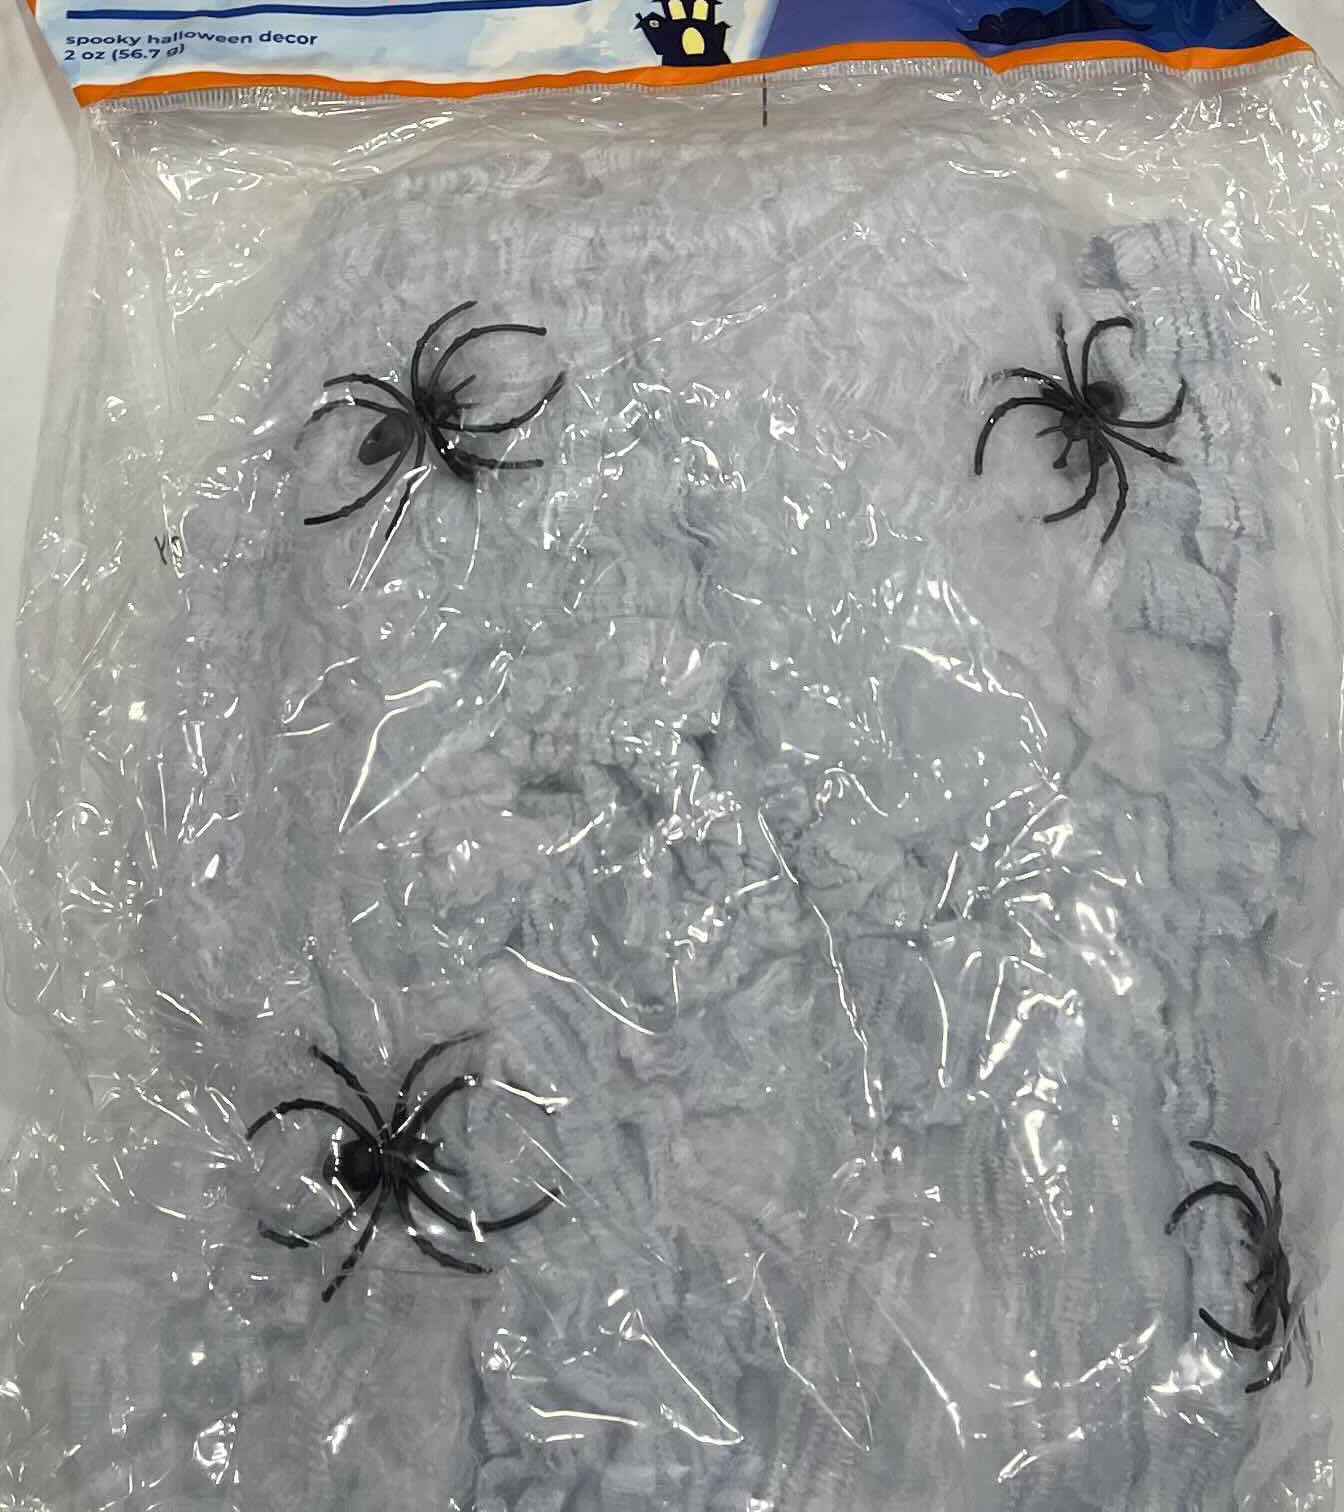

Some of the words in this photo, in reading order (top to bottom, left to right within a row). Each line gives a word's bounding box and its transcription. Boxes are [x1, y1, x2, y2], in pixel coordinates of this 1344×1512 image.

[65, 33, 141, 50] spooky
[147, 29, 253, 47] halloween
[259, 29, 318, 47] decor
[63, 49, 74, 61] 2
[80, 51, 106, 61] oz
[111, 48, 160, 63] (56.7
[166, 43, 185, 60] g)
